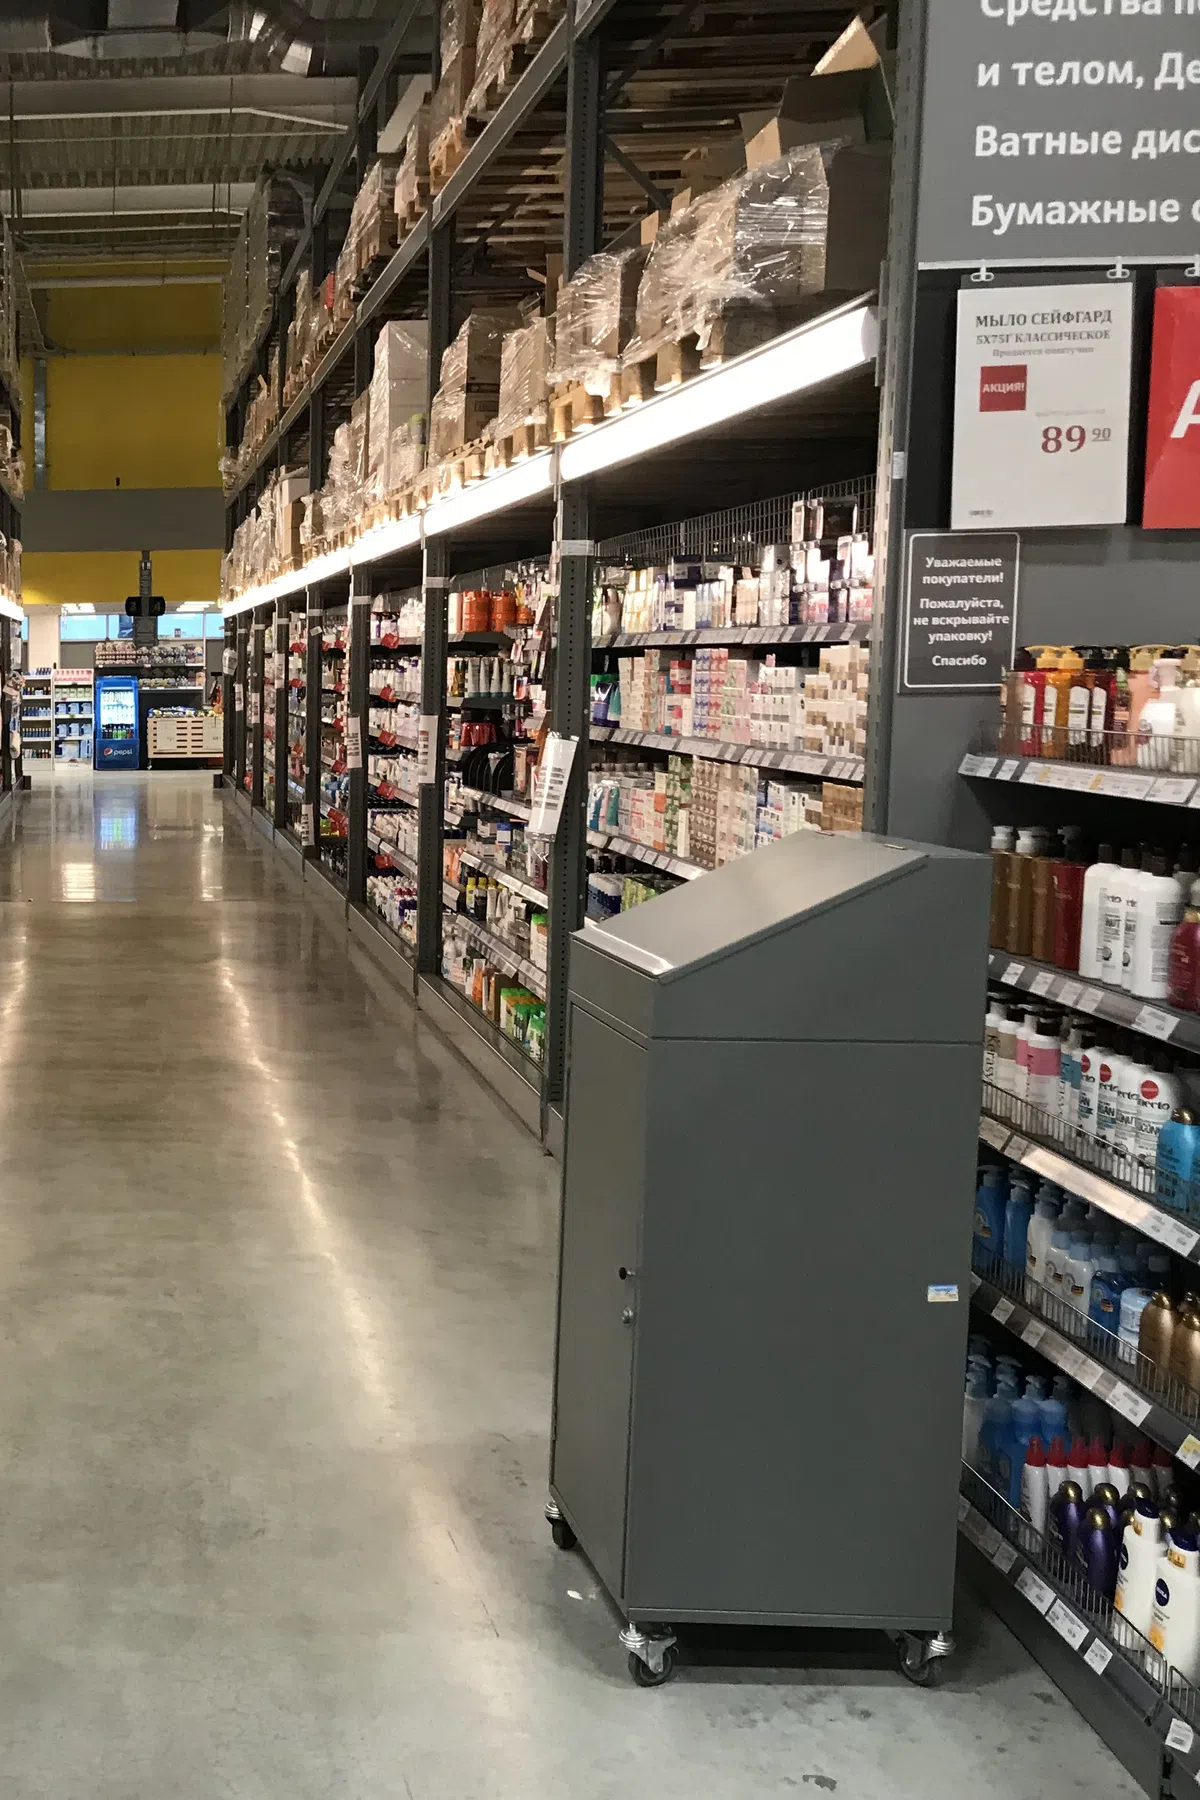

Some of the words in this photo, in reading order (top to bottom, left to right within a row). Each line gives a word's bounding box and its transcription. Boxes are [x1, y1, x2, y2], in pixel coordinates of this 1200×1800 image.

[980, 0, 1162, 26] Средства
[977, 61, 1000, 87] и
[1011, 60, 1144, 89] телом,
[1154, 51, 1200, 90] Де
[975, 125, 1122, 157] Ватные
[1131, 129, 1200, 160] дис
[971, 195, 1180, 235] Бумажные
[975, 314, 1027, 328] МЫЛО
[1031, 309, 1113, 326] СЕЙФГАРД
[1014, 330, 1111, 343] КЛАССИЧЕСКОЕ
[982, 382, 1025, 394] АКЦИЯ!
[1041, 425, 1086, 454] 89
[1092, 428, 1111, 442] 90
[926, 557, 1002, 568] Уважаемые
[922, 572, 1004, 587] покупатели!
[920, 597, 1004, 611] Пожалуйста,
[913, 616, 929, 626] не
[932, 614, 1010, 628] вскрывайте
[928, 631, 992, 645] упаковку!
[932, 655, 987, 666] Спасибо
[113, 748, 133, 756] pepsi
